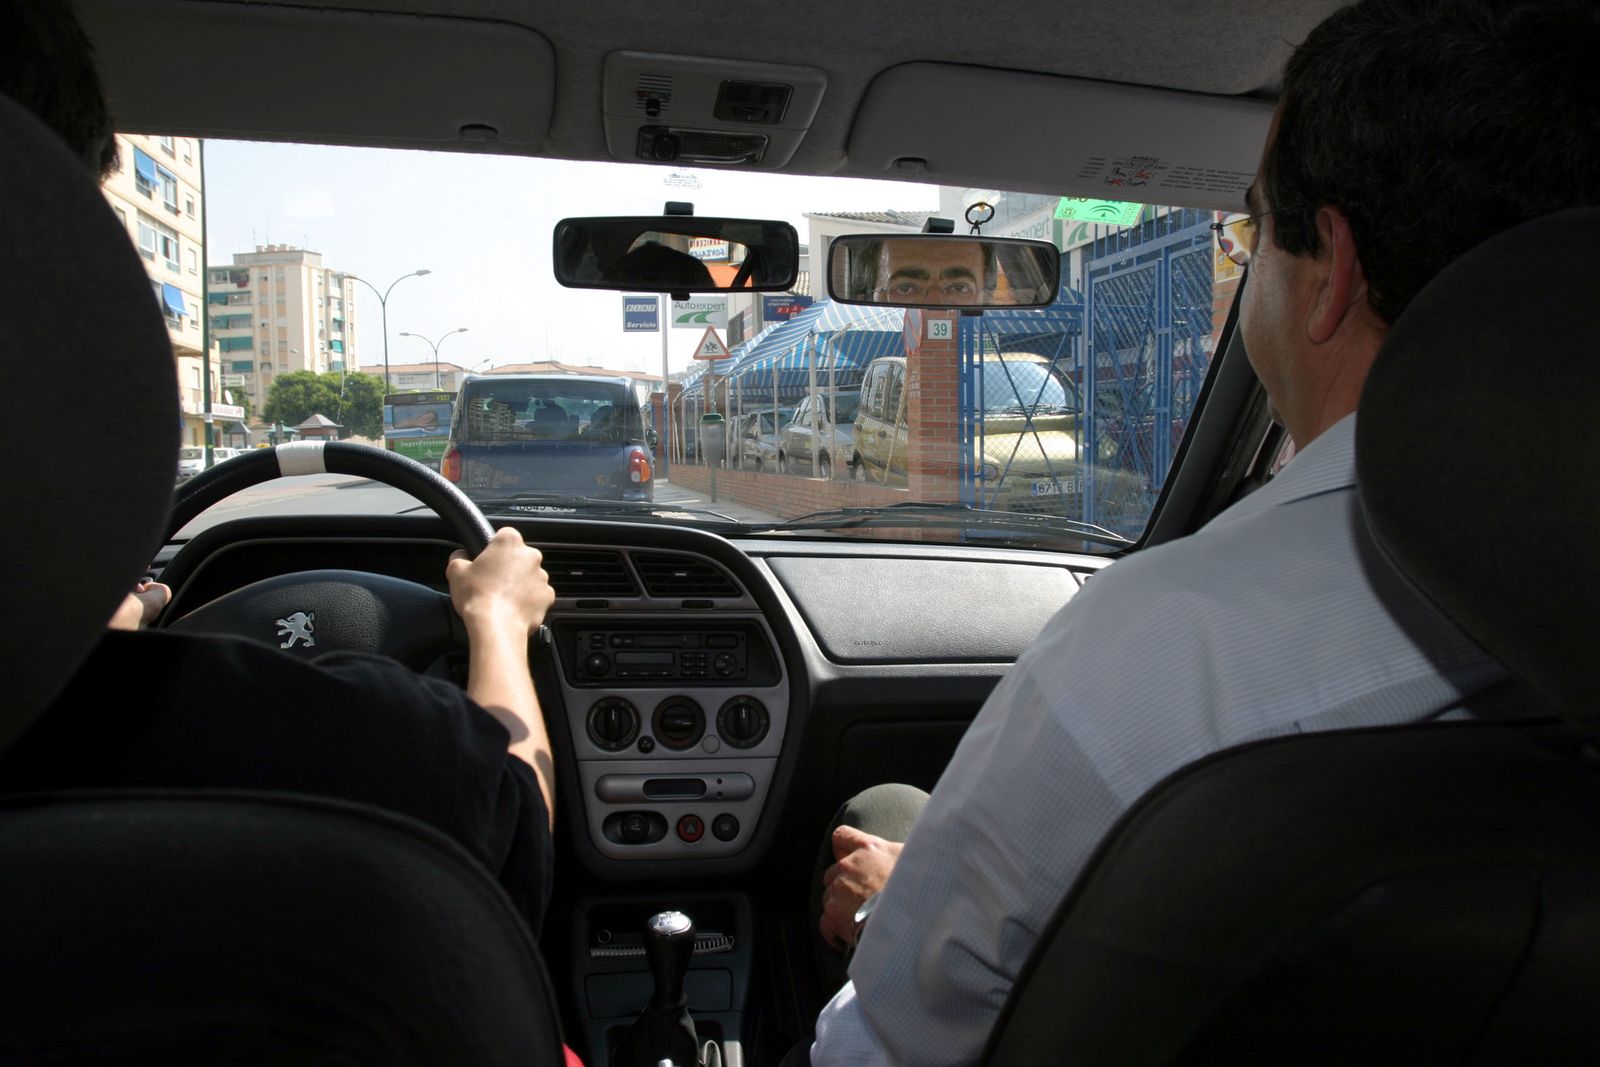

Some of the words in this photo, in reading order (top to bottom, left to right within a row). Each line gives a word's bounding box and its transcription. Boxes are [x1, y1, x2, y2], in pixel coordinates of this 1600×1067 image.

[625, 304, 656, 312] FIAT
[626, 321, 657, 329] Servicio
[933, 322, 948, 336] 39
